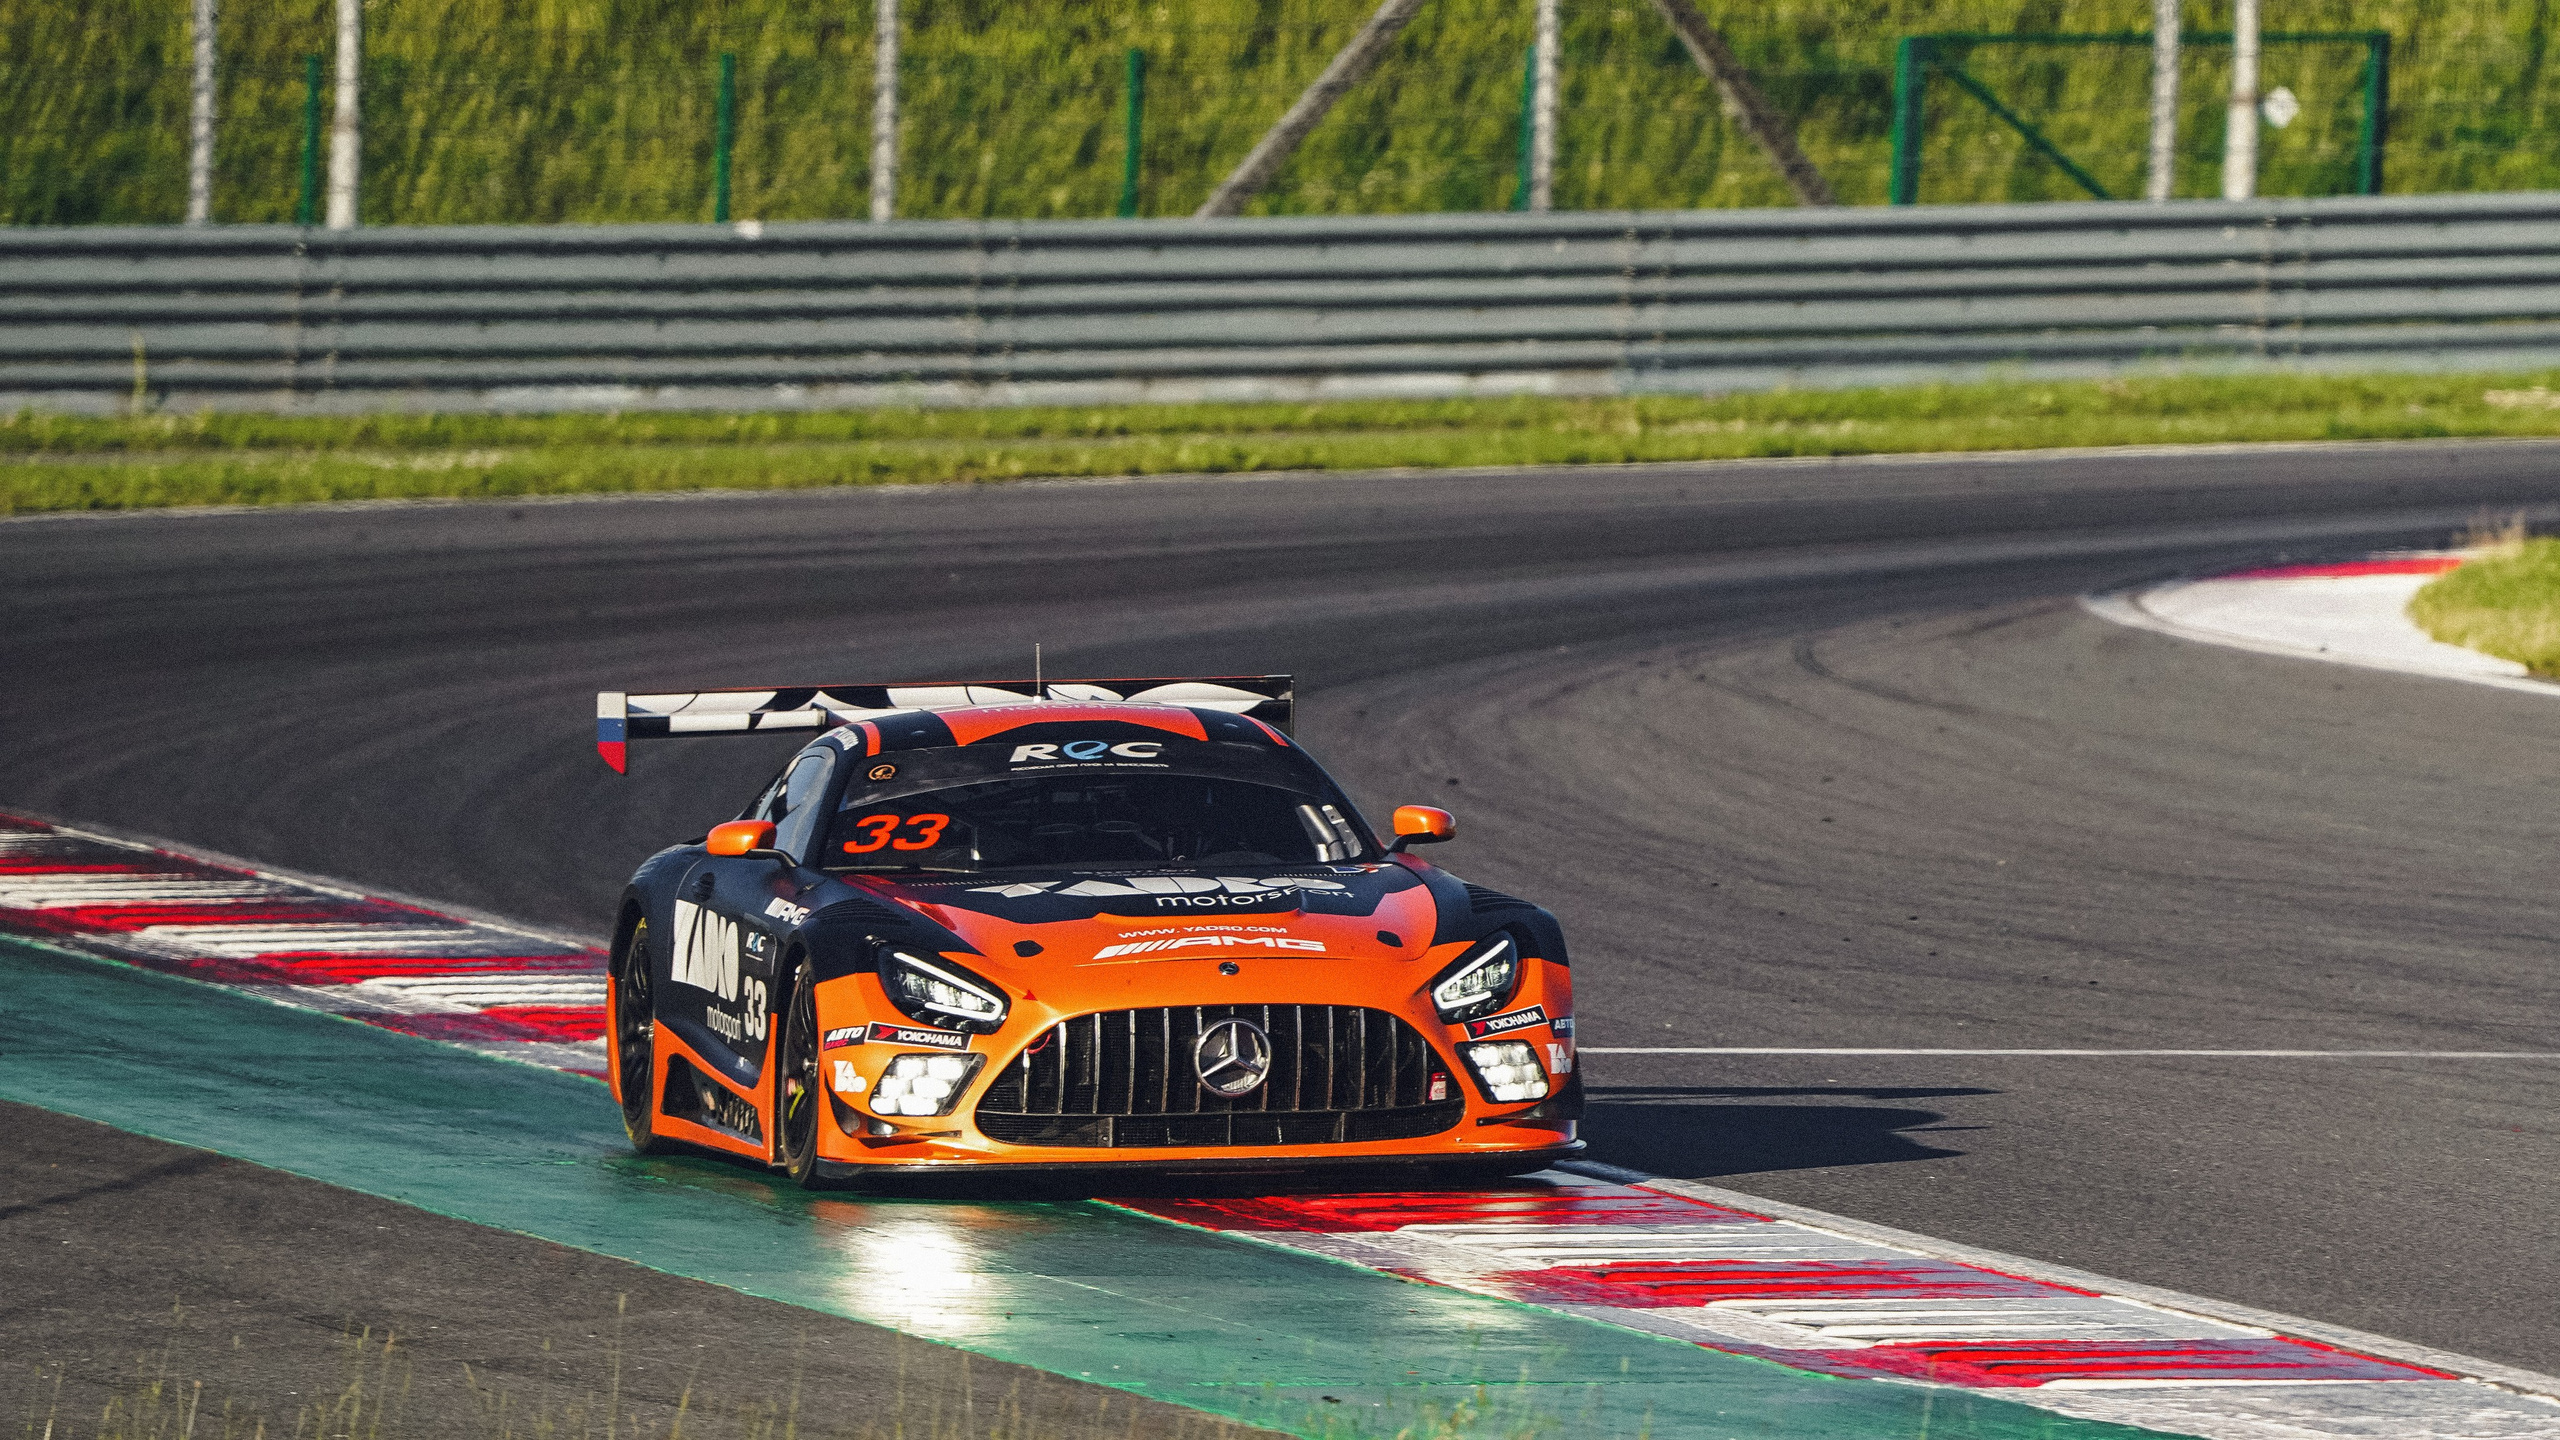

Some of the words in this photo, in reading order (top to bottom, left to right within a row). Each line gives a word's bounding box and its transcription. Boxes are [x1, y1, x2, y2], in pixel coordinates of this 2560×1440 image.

[843, 813, 950, 854] 33
[1155, 885, 1355, 907] motorsport
[671, 899, 739, 1002] YADRO
[707, 1003, 741, 1043] motorsport
[744, 976, 767, 1041] 33
[1486, 1011, 1541, 1030] YOKOHAMA
[827, 1026, 865, 1042] АВТО
[897, 1030, 962, 1046] YOKOHAMA
